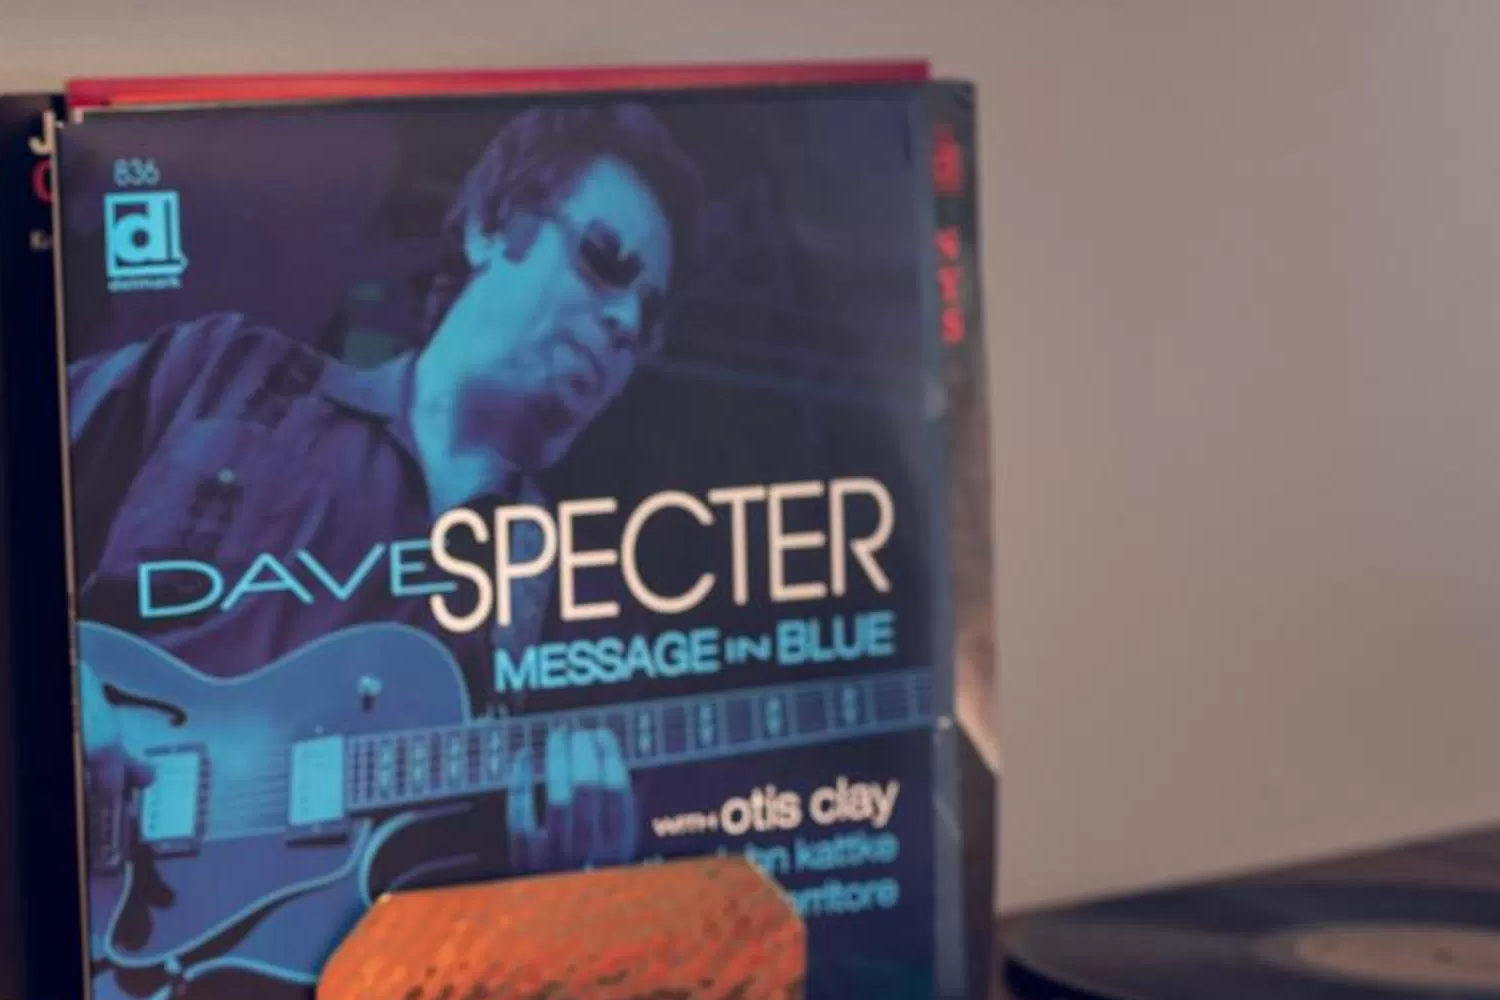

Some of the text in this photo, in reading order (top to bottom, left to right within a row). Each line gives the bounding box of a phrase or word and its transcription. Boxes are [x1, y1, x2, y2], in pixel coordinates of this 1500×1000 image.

[113, 158, 162, 187] 836
[138, 476, 897, 634] DAVE SPECTER
[494, 611, 897, 693] MESSAGE IN BLUE
[720, 784, 801, 835] otis
[809, 775, 900, 828] clay
